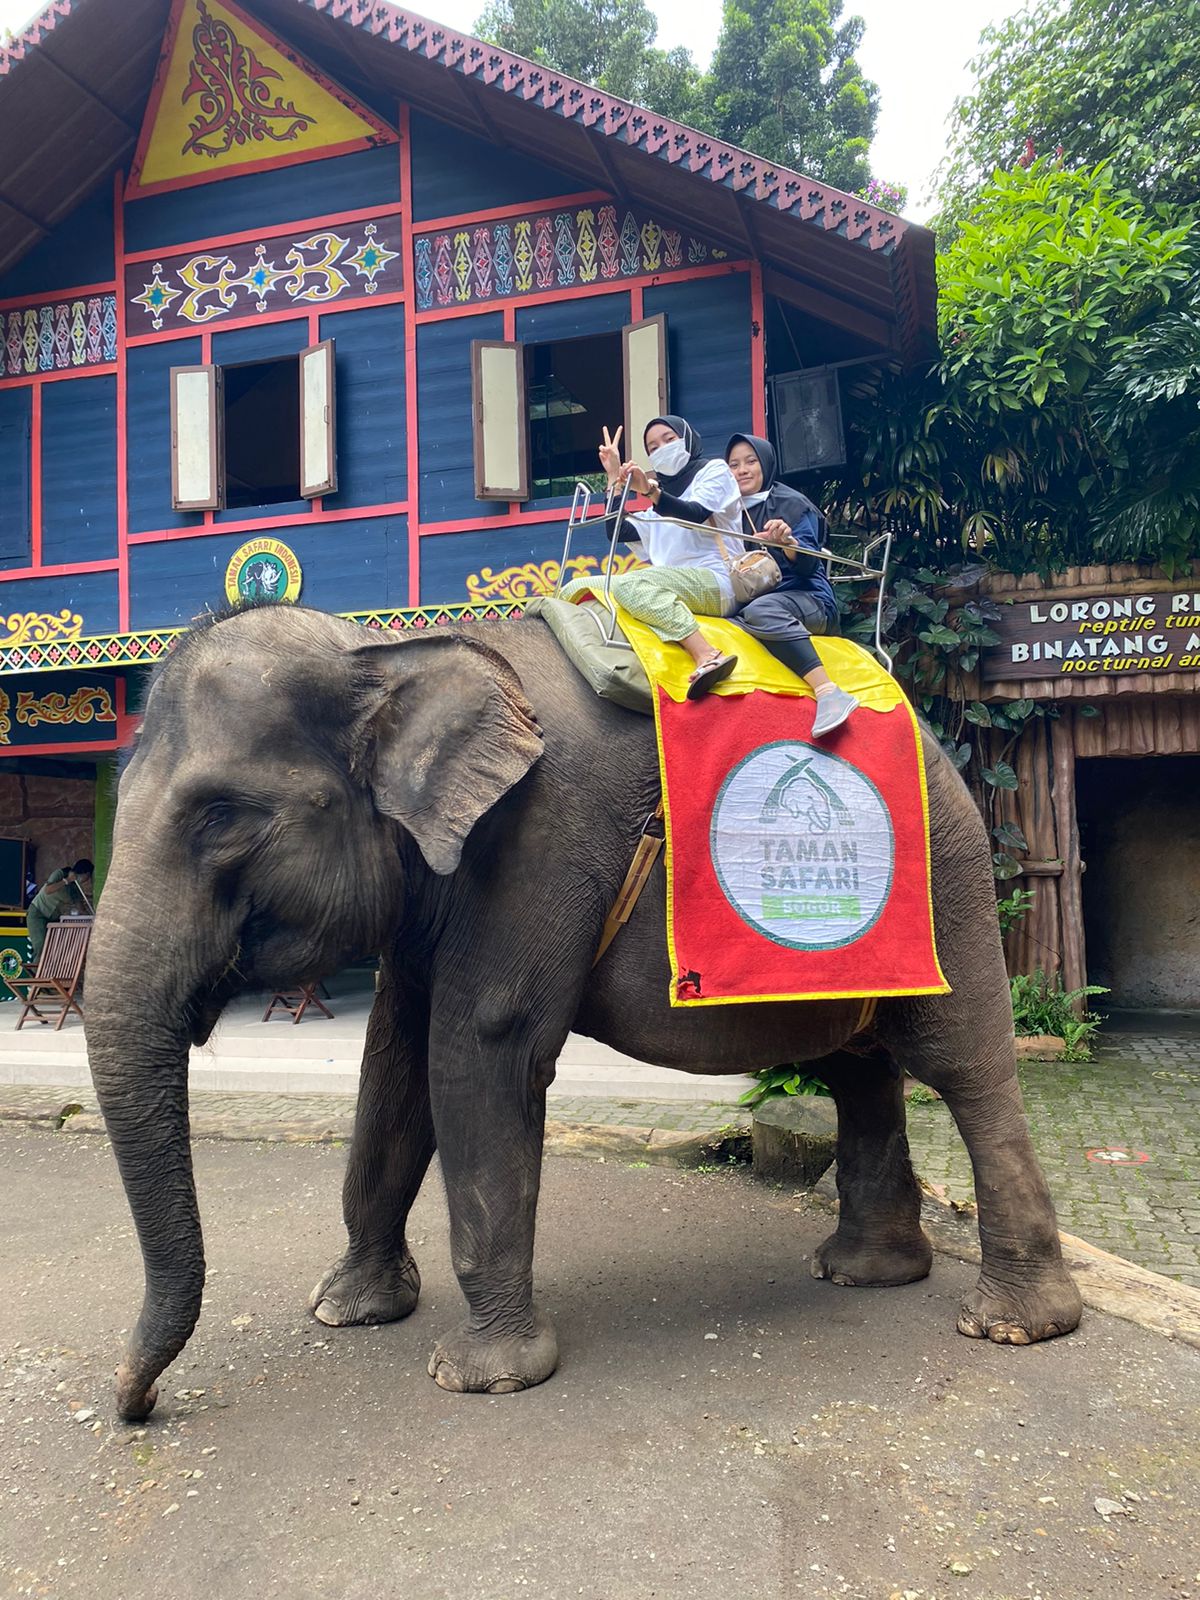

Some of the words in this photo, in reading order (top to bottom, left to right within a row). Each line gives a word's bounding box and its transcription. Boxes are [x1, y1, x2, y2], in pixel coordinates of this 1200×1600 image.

[228, 556, 243, 588] TAMAN
[242, 541, 272, 557] SAFARI
[274, 544, 299, 584] INDONESIA
[1030, 597, 1156, 623] LORONG
[1078, 616, 1156, 635] reptile
[1012, 635, 1168, 662] BINATANG
[1061, 653, 1174, 673] nocturnal
[759, 839, 858, 863] TAMAN
[760, 866, 860, 890] SAFARI
